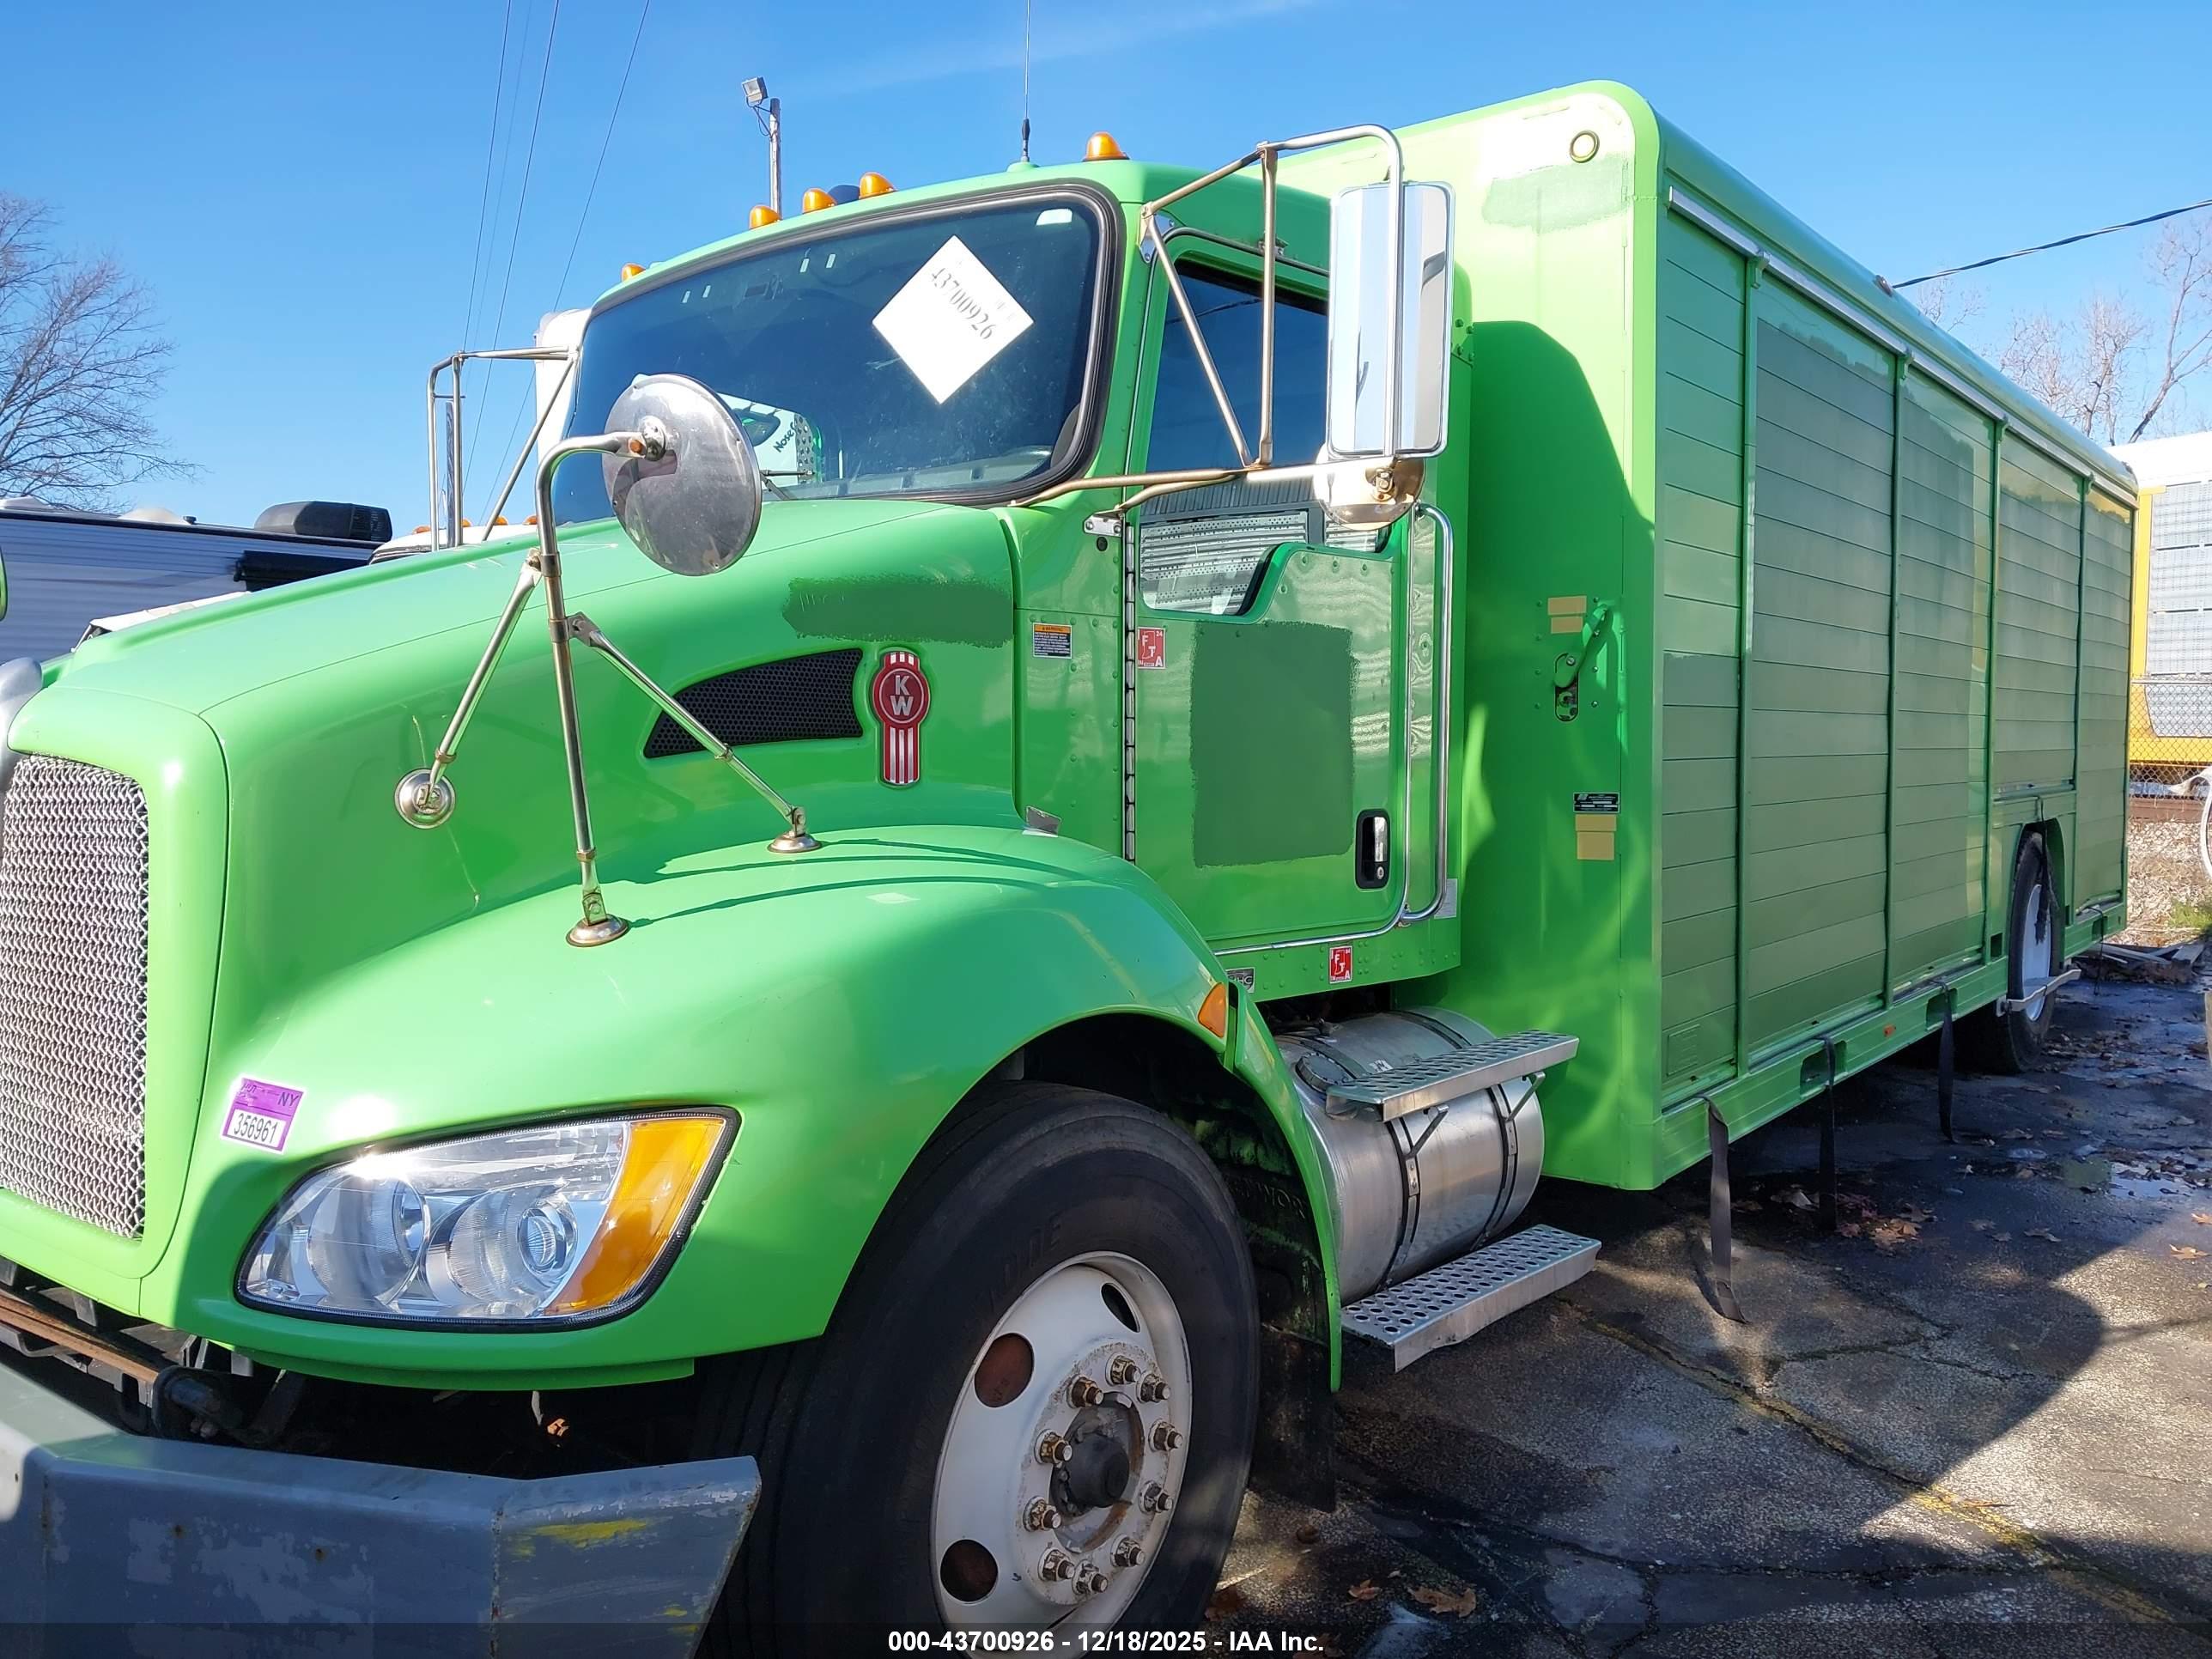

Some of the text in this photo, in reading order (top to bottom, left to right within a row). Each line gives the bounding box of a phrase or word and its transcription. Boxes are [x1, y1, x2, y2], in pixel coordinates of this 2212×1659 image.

[931, 268, 997, 339] 43700926
[277, 1091, 299, 1107] NY
[234, 1112, 278, 1144] 356961
